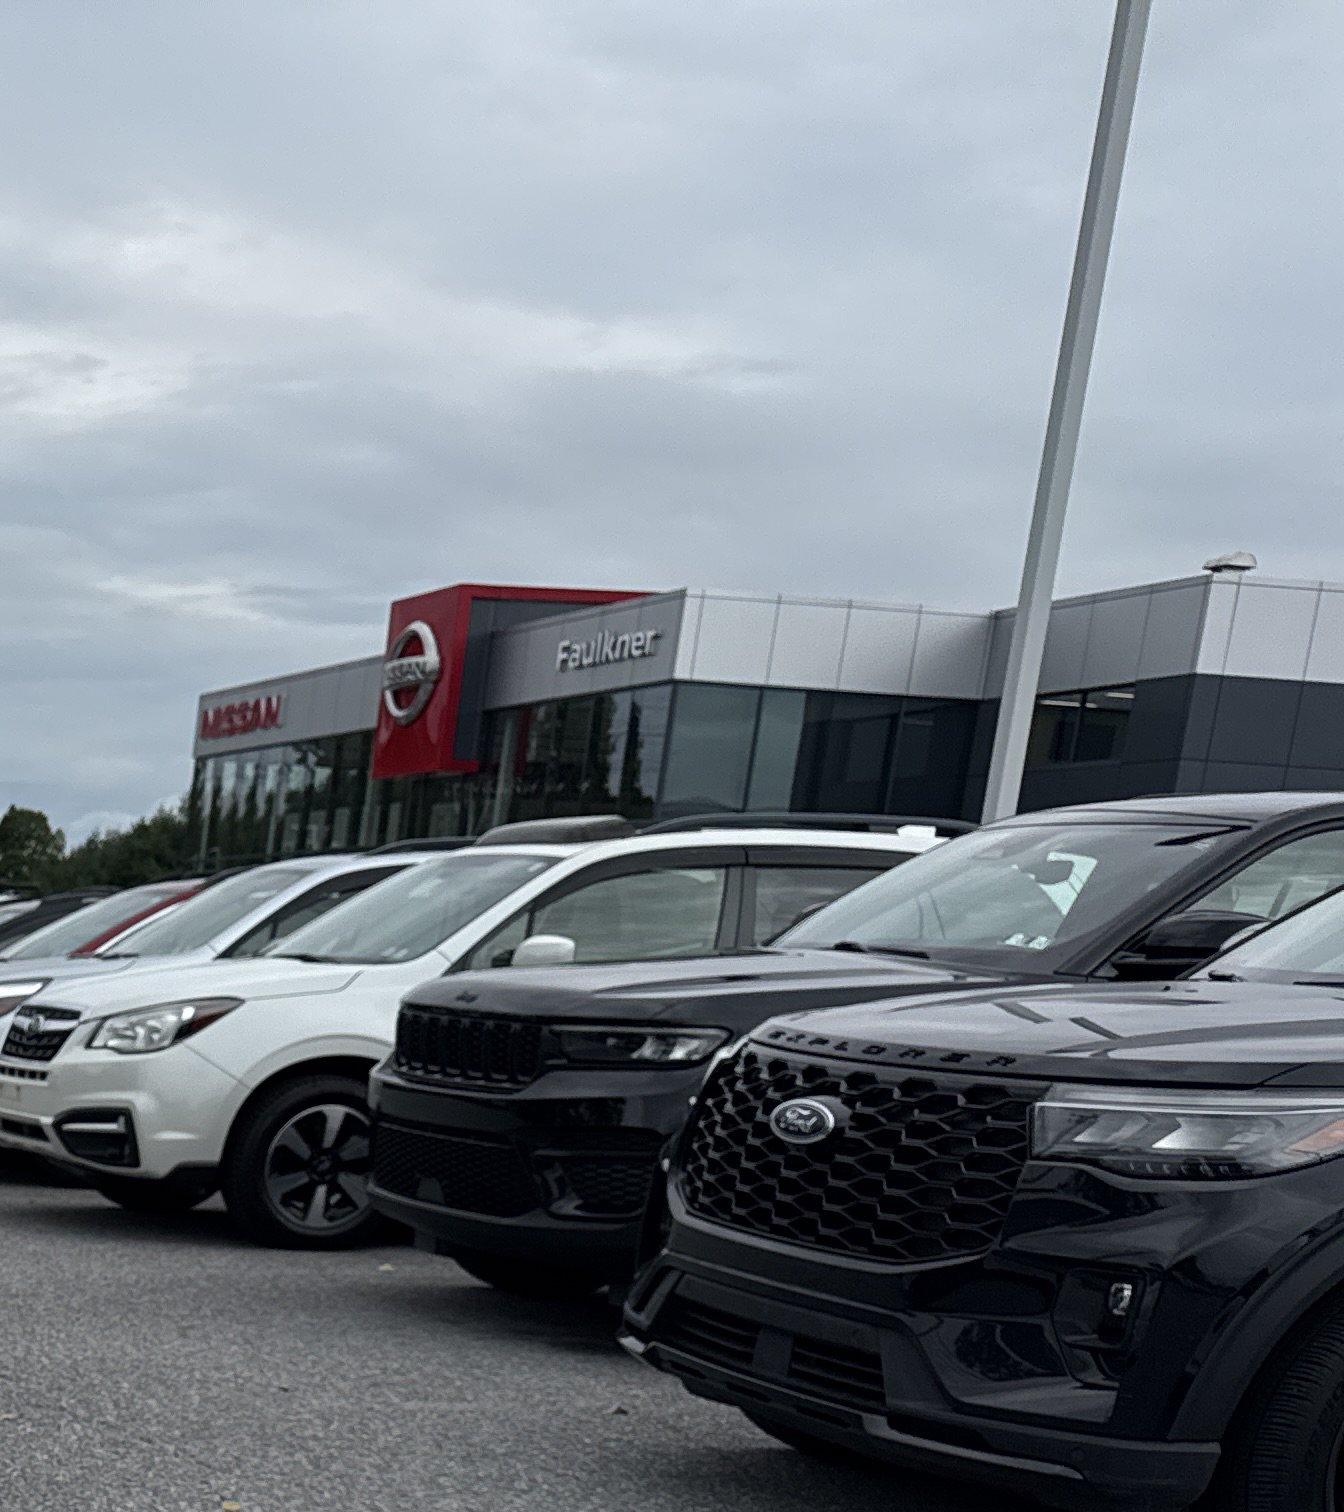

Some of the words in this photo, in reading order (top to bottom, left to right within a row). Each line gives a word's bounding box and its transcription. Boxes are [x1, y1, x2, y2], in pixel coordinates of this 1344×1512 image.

[555, 629, 657, 670] Faulkner
[200, 695, 282, 739] NISSAN
[768, 1030, 1016, 1067] EXPLORER
